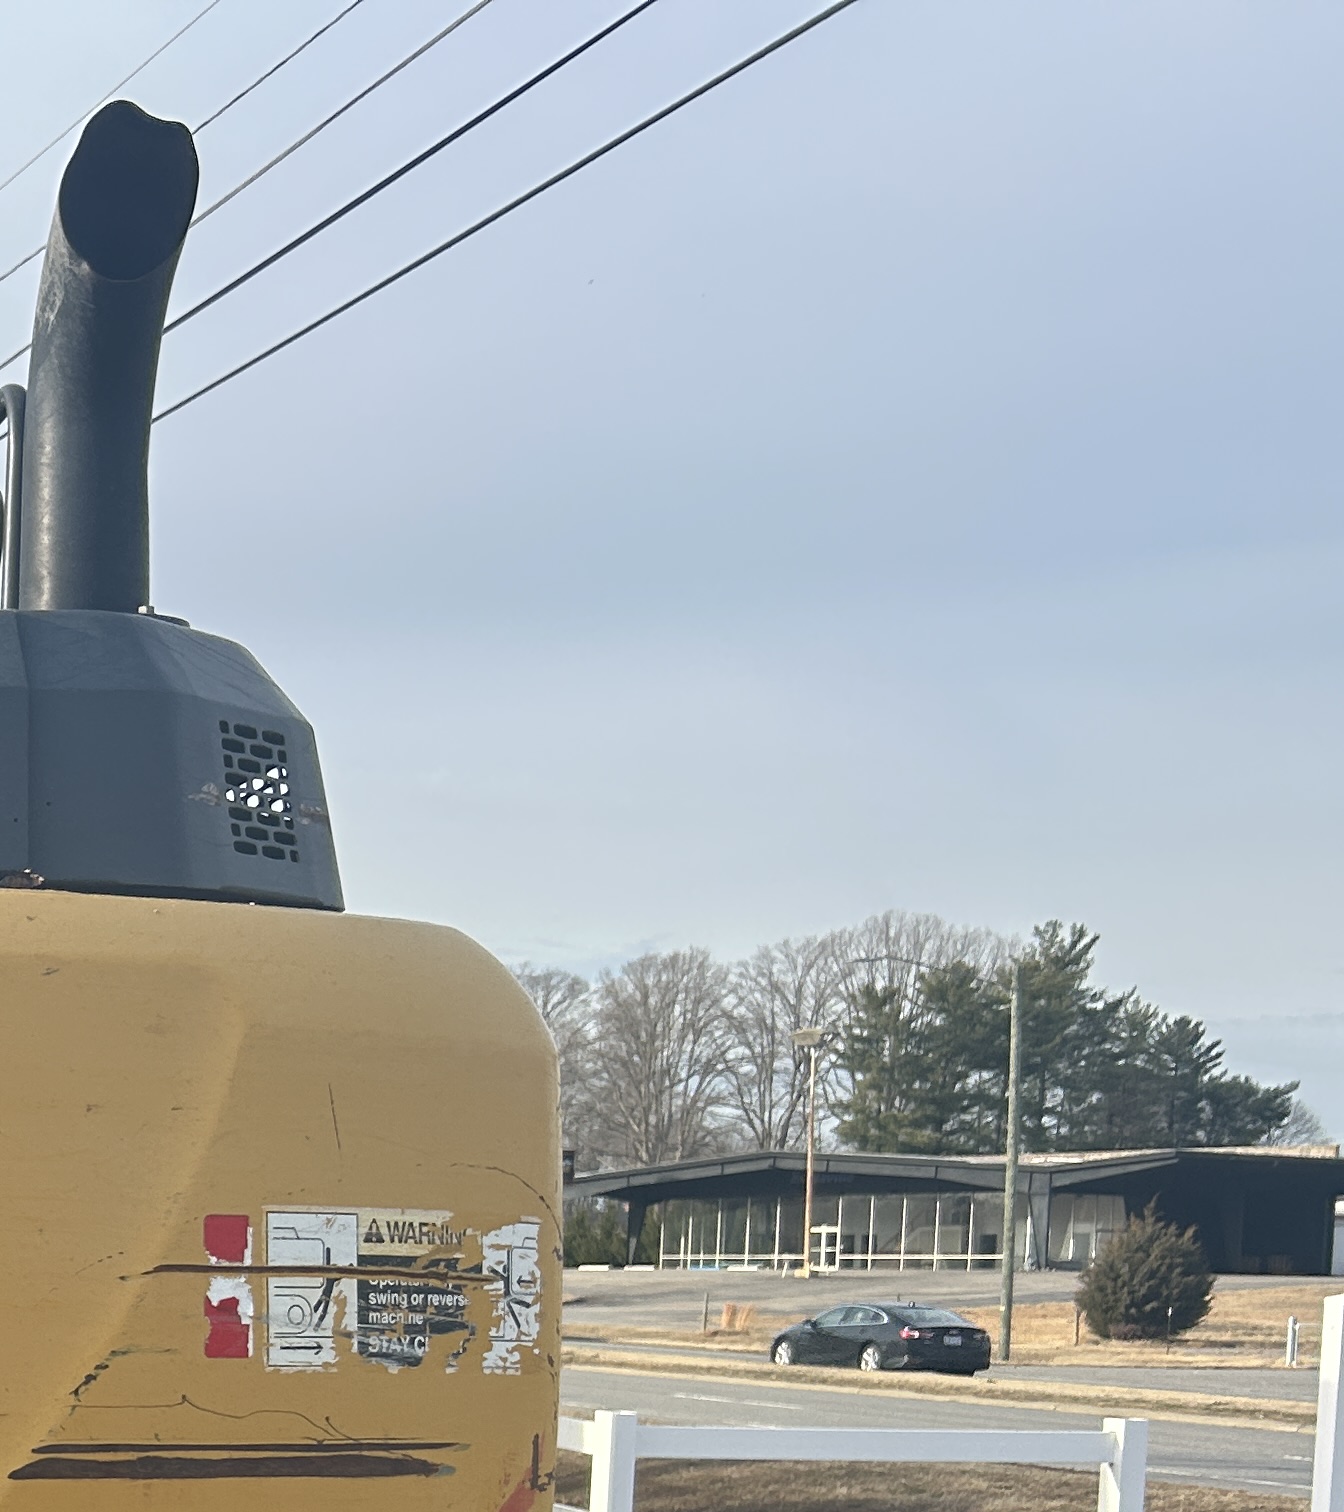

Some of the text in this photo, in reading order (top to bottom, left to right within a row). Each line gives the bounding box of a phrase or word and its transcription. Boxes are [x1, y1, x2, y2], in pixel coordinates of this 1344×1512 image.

[385, 1220, 469, 1246] WARNIN
[368, 1290, 409, 1308] swing
[411, 1293, 425, 1305] or
